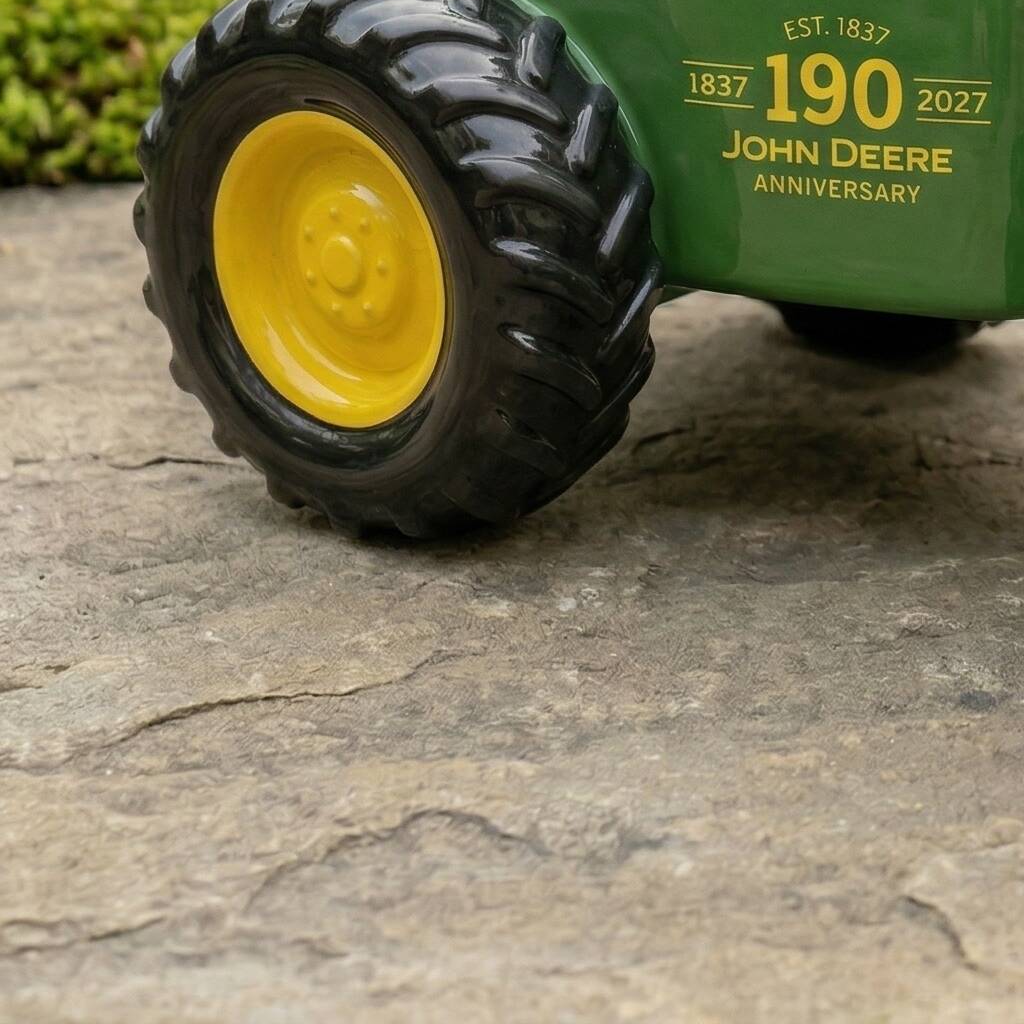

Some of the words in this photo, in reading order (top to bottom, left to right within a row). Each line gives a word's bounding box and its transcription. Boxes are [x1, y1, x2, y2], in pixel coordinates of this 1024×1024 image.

[783, 15, 830, 41] EST.
[837, 16, 891, 46] 1837
[689, 72, 749, 98] 1837
[766, 52, 903, 131] 190
[916, 88, 989, 114] 2027
[721, 129, 819, 166] JOHN
[830, 137, 953, 174] DEERE
[753, 174, 921, 204] ANNIVERSARY
